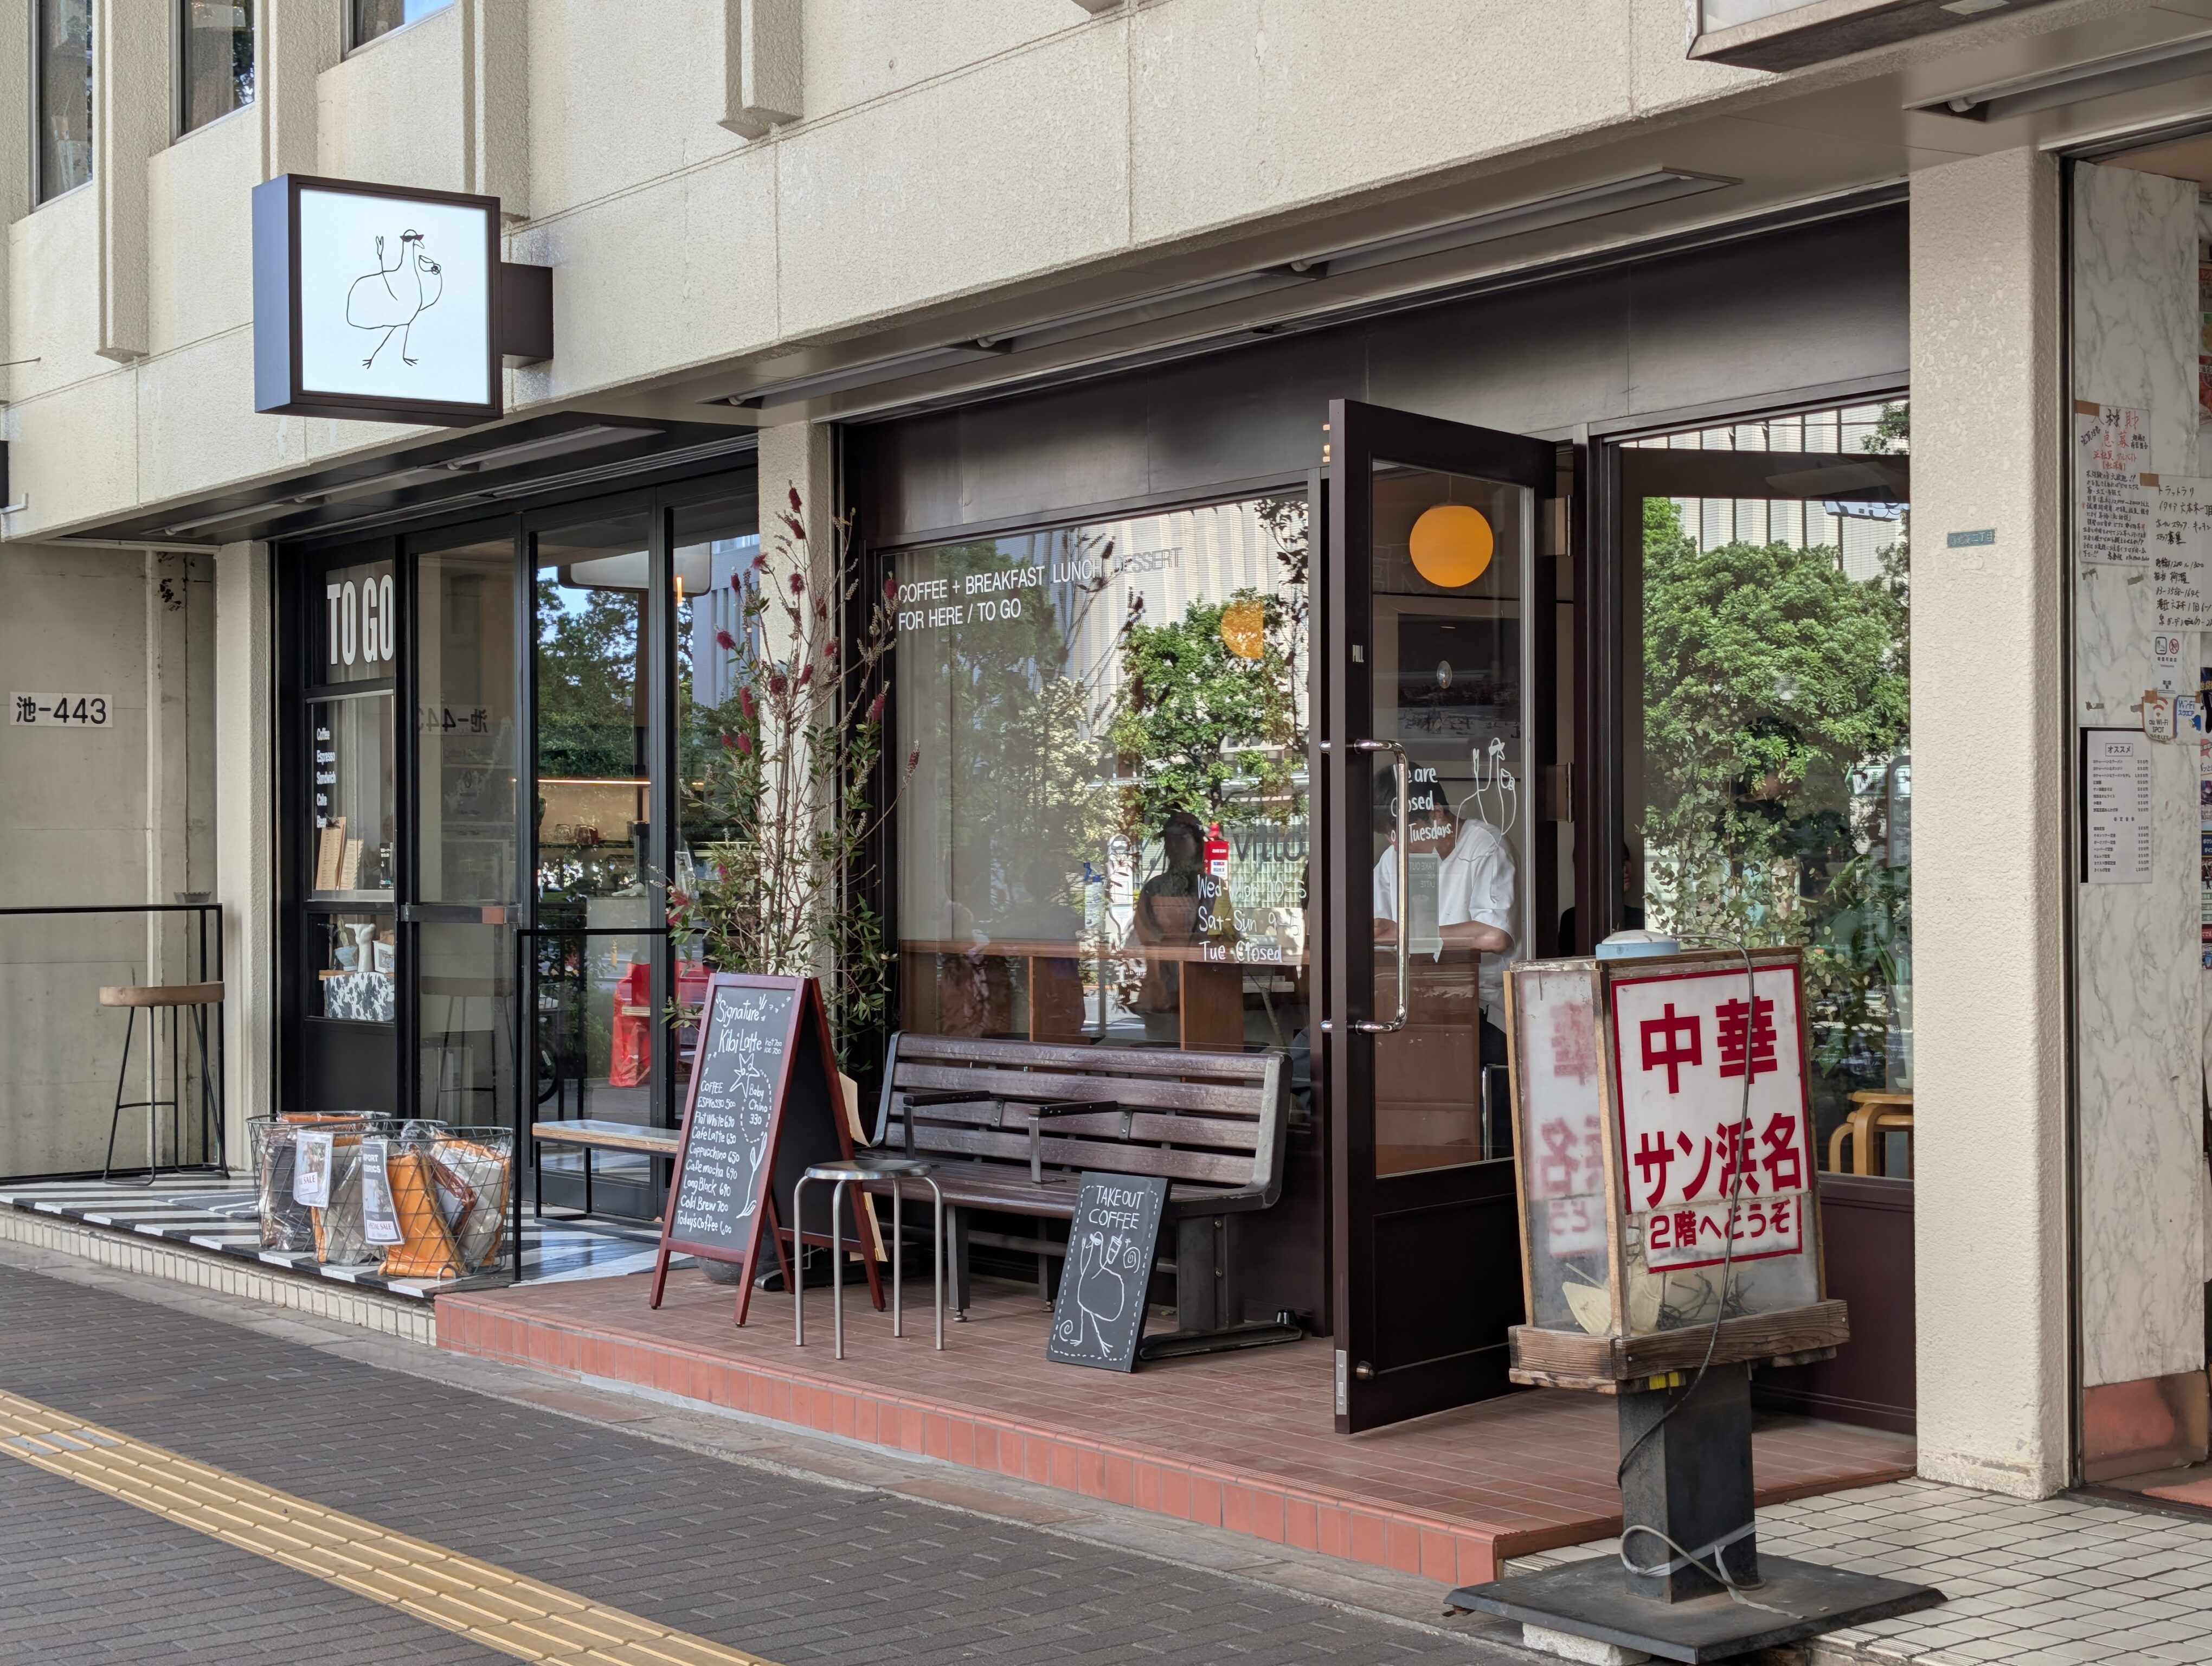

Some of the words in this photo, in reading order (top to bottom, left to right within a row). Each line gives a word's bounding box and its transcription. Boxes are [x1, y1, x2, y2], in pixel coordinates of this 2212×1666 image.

[898, 579, 948, 603] COFFEE
[966, 566, 1045, 595] BREAKFAST
[1053, 559, 1102, 584] LUNCH
[327, 581, 356, 665] TO
[363, 574, 394, 663] GO
[898, 611, 924, 632] FOR
[929, 605, 963, 627] HERE
[979, 601, 996, 621] TO
[1000, 598, 1021, 619] GO
[16, 696, 106, 724] 池-443
[317, 749, 336, 765] Espresso
[2107, 746, 2131, 754] オススメ
[1414, 767, 1438, 783] are
[1199, 941, 1226, 962] Tue
[716, 999, 760, 1028] Signature
[1639, 996, 1778, 1094] 中華
[749, 1084, 764, 1101] Baby
[749, 1100, 768, 1112] Chino
[749, 1114, 762, 1125] 330
[1634, 1113, 1802, 1209] サン浜名
[303, 1175, 316, 1183] SALE
[726, 1167, 737, 1180] 690
[719, 1183, 731, 1197] 690
[680, 1195, 697, 1209] Cold
[697, 1196, 716, 1212] Brew
[717, 1201, 728, 1213] 700
[1089, 1208, 1140, 1229] COFFEE
